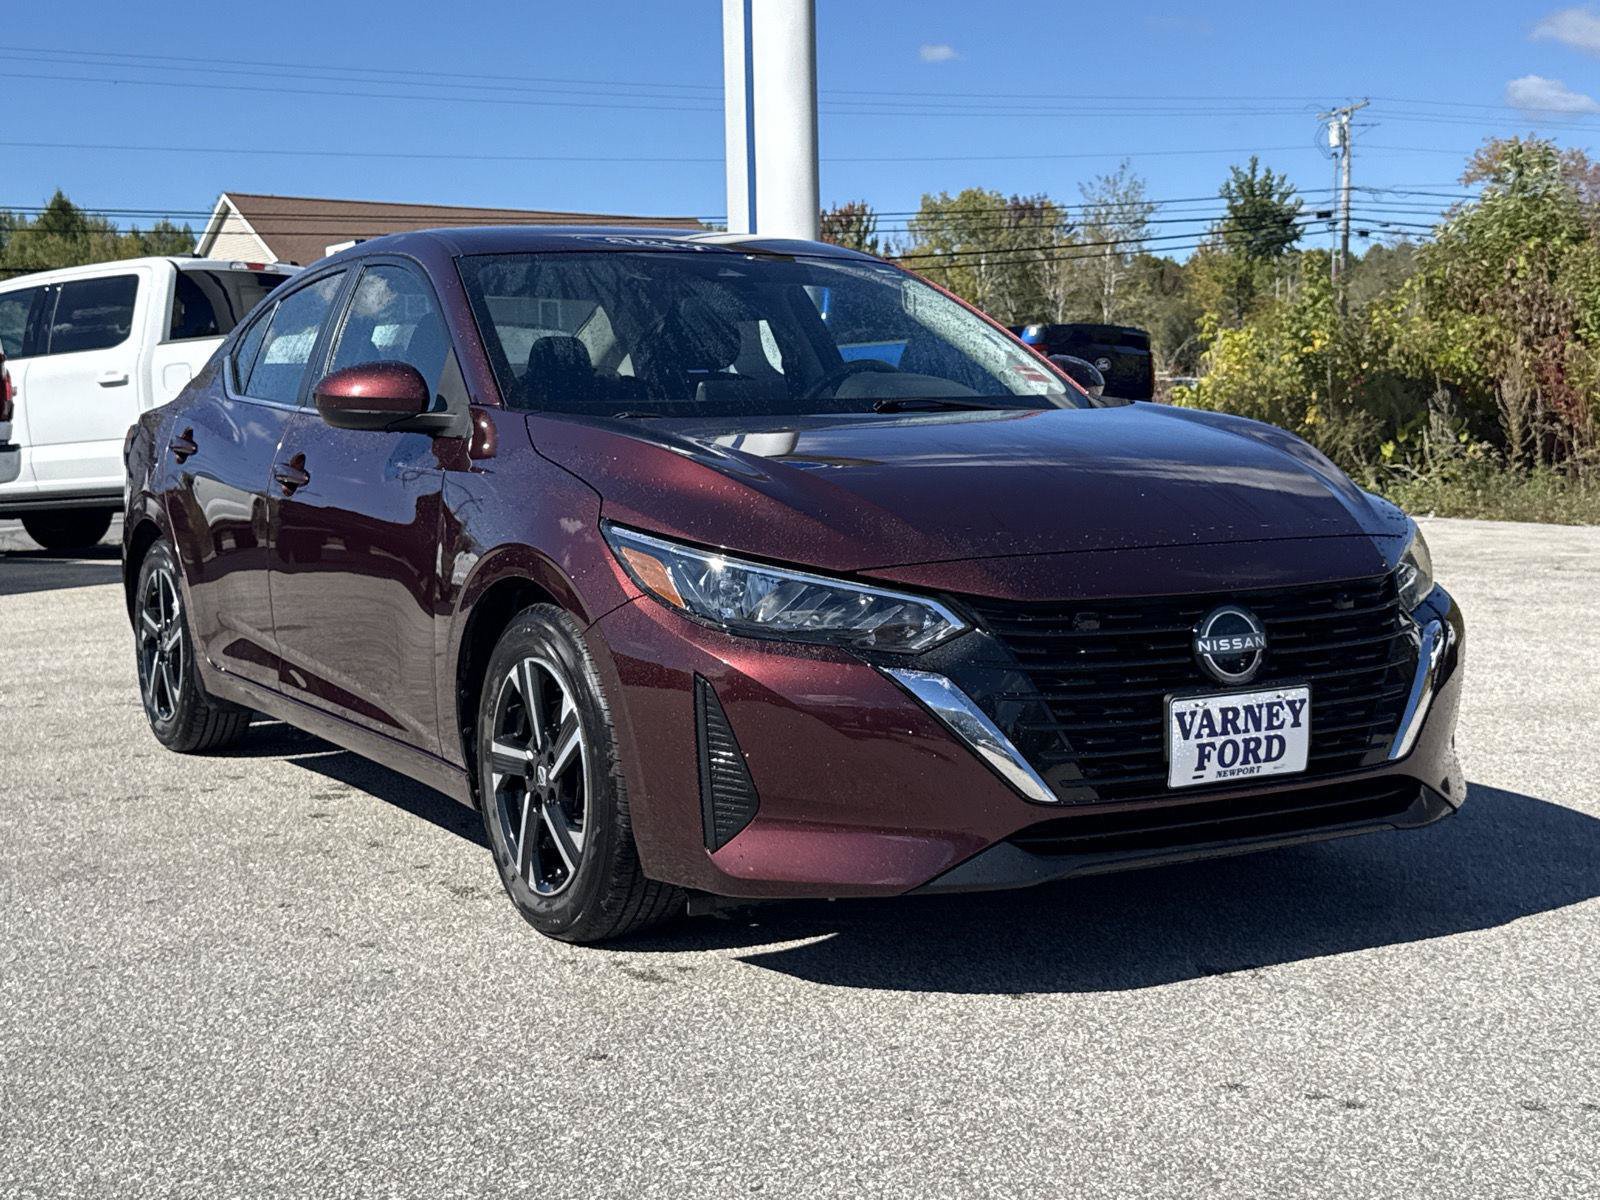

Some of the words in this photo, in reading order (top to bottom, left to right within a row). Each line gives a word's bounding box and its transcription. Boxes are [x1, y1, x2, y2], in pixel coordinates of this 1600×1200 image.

[1197, 636, 1265, 652] NISSAN
[1175, 698, 1307, 740] VARNEY
[1194, 734, 1286, 772] FORD
[1215, 766, 1262, 779] NEWPORT
